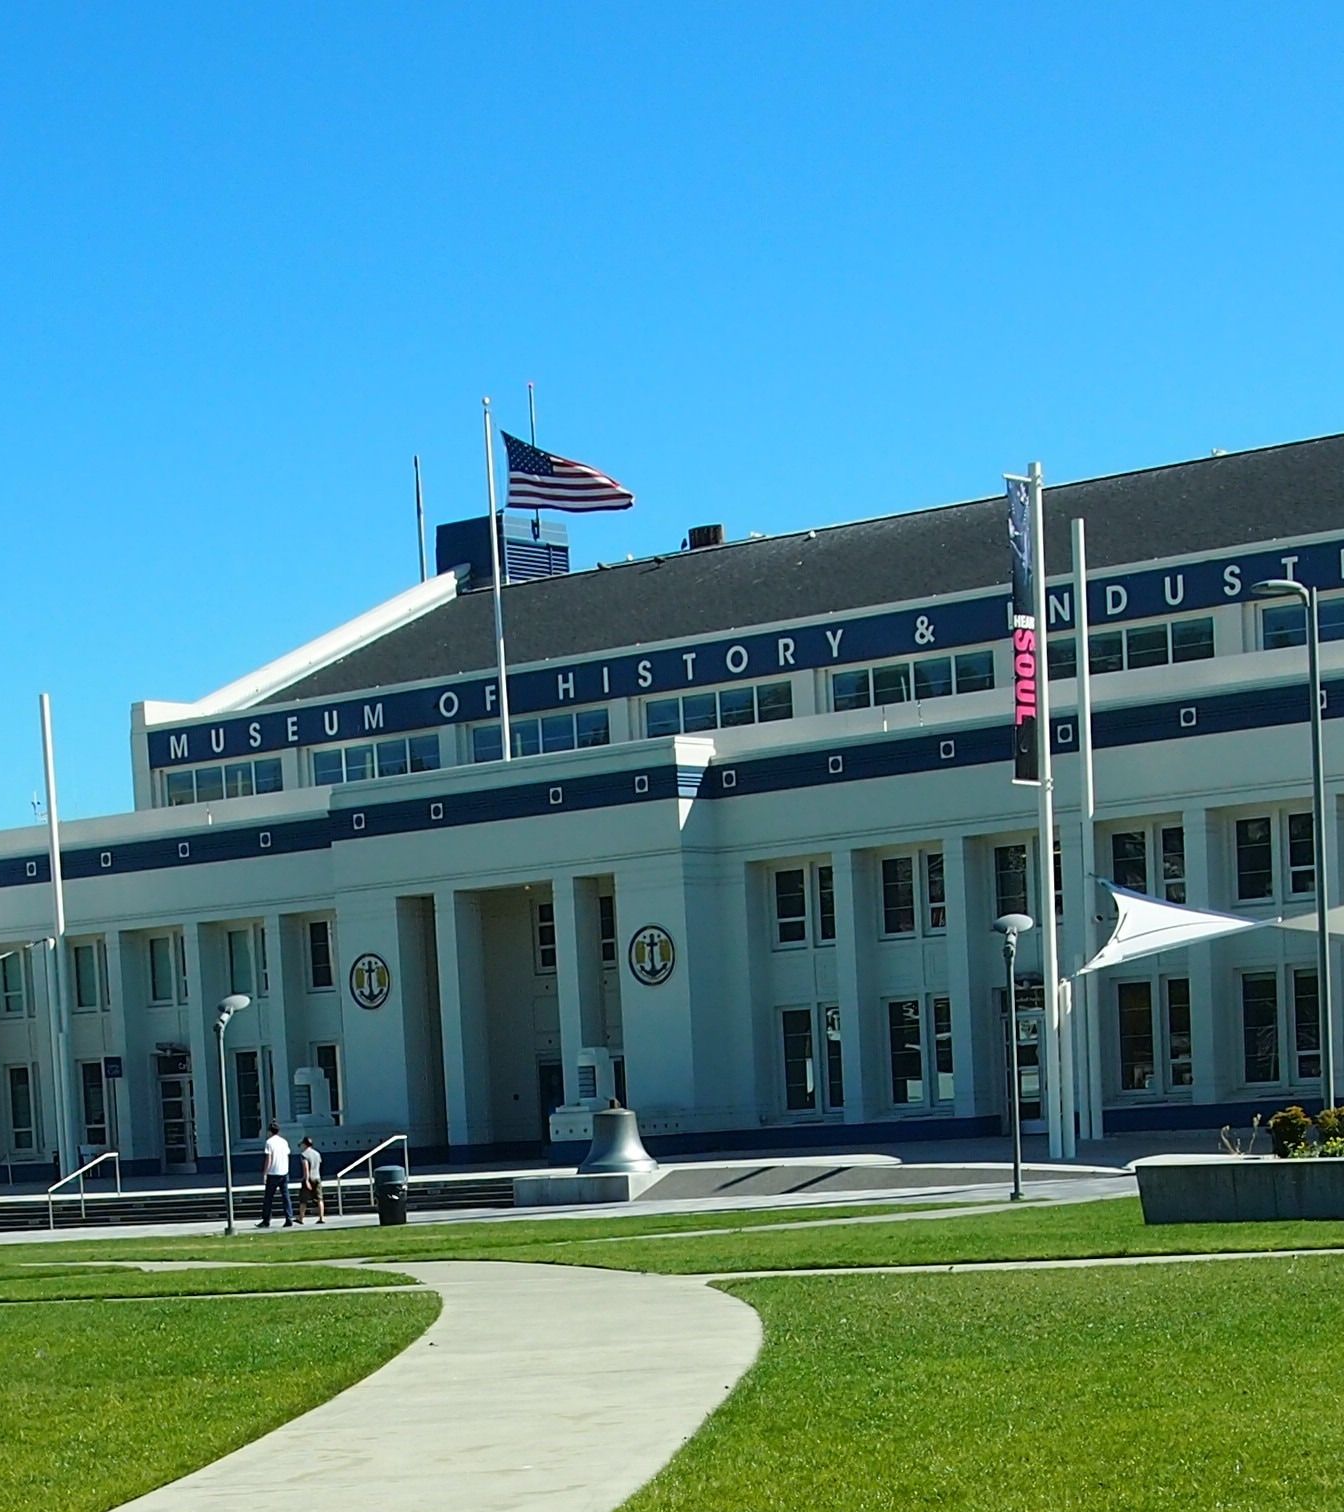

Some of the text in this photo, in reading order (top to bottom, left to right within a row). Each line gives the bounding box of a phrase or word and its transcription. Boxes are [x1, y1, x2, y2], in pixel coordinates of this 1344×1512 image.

[169, 703, 384, 760] MUSEUM
[439, 684, 497, 718] OF
[557, 628, 845, 700] HISTORY
[914, 615, 936, 646] &
[1014, 628, 1037, 725] SOUL
